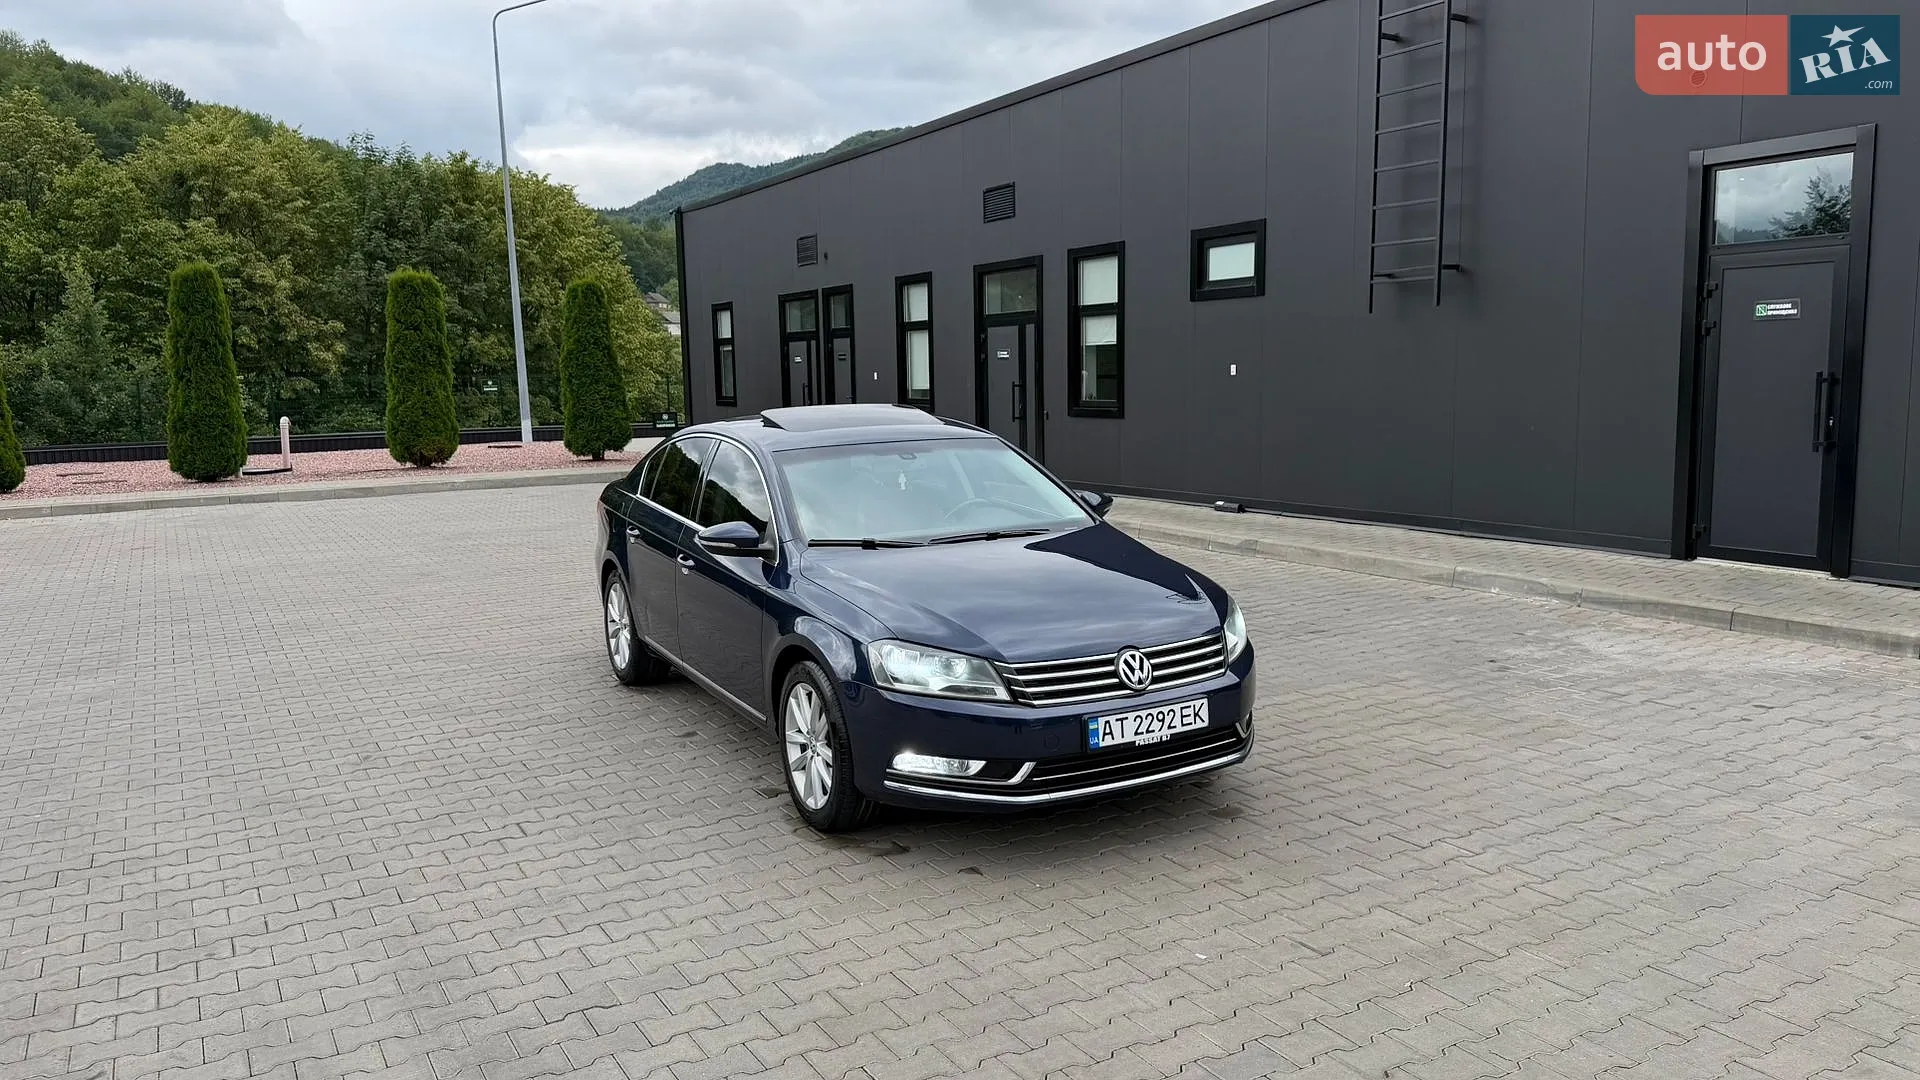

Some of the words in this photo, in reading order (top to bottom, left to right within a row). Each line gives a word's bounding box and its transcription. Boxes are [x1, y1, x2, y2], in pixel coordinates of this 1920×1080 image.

[1119, 650, 1152, 690] VW
[1089, 736, 1099, 745] UA
[1102, 716, 1128, 741] AT
[1133, 708, 1177, 736] 2292
[1180, 702, 1205, 727] EK
